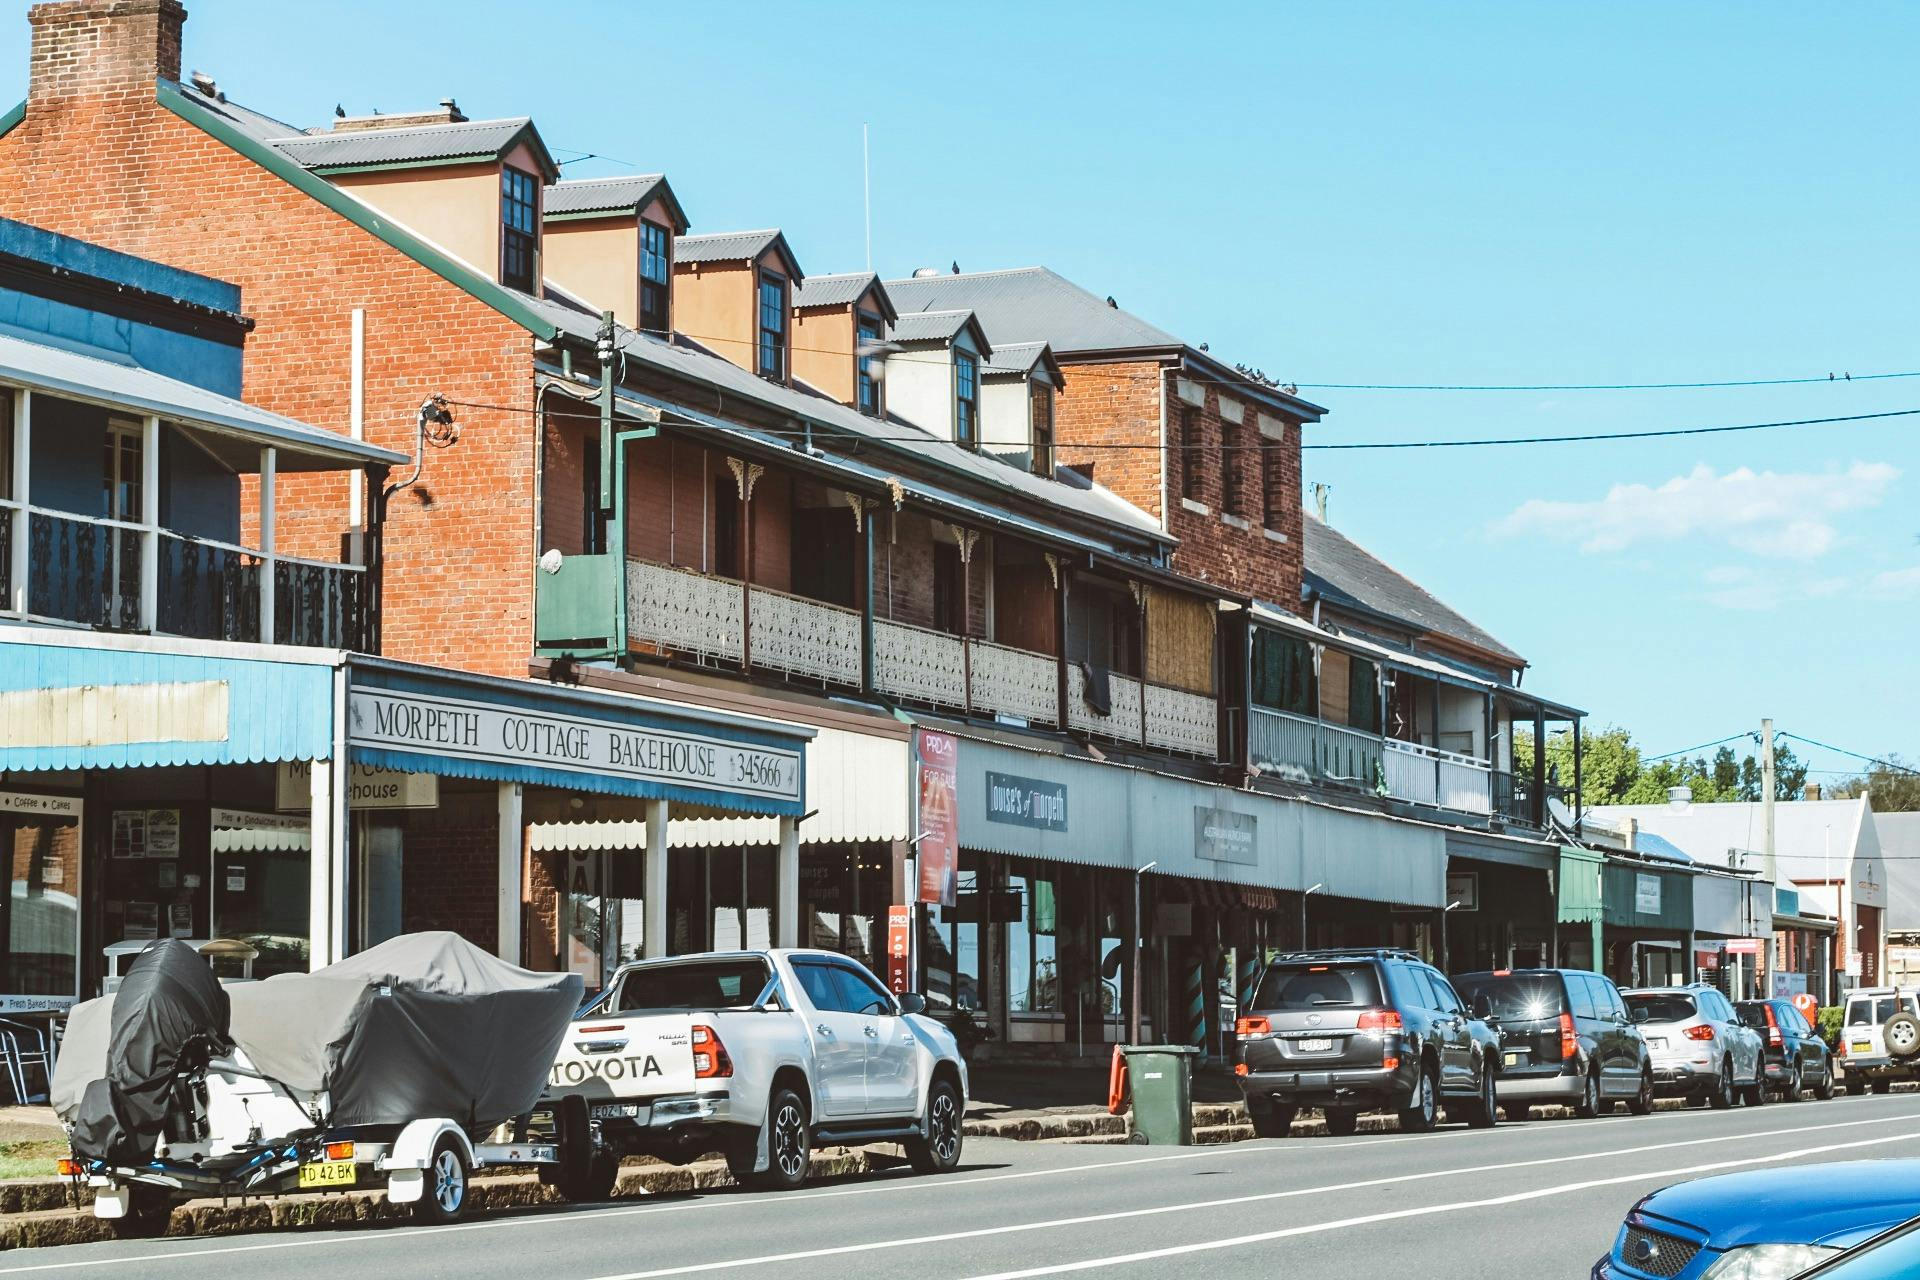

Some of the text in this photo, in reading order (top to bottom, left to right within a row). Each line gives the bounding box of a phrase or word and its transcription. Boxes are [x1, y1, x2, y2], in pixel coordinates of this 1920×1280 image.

[374, 701, 782, 787] MORPETH COTTAGE BAKEHOUSE 345666
[924, 769, 939, 785] FOR
[14, 797, 72, 810] Coffee Cakes
[1033, 788, 1064, 827] morpeth
[28, 999, 46, 1010] Baked
[553, 1055, 663, 1084] TOYOTA
[301, 1167, 316, 1181] TD
[320, 1165, 334, 1180] 42
